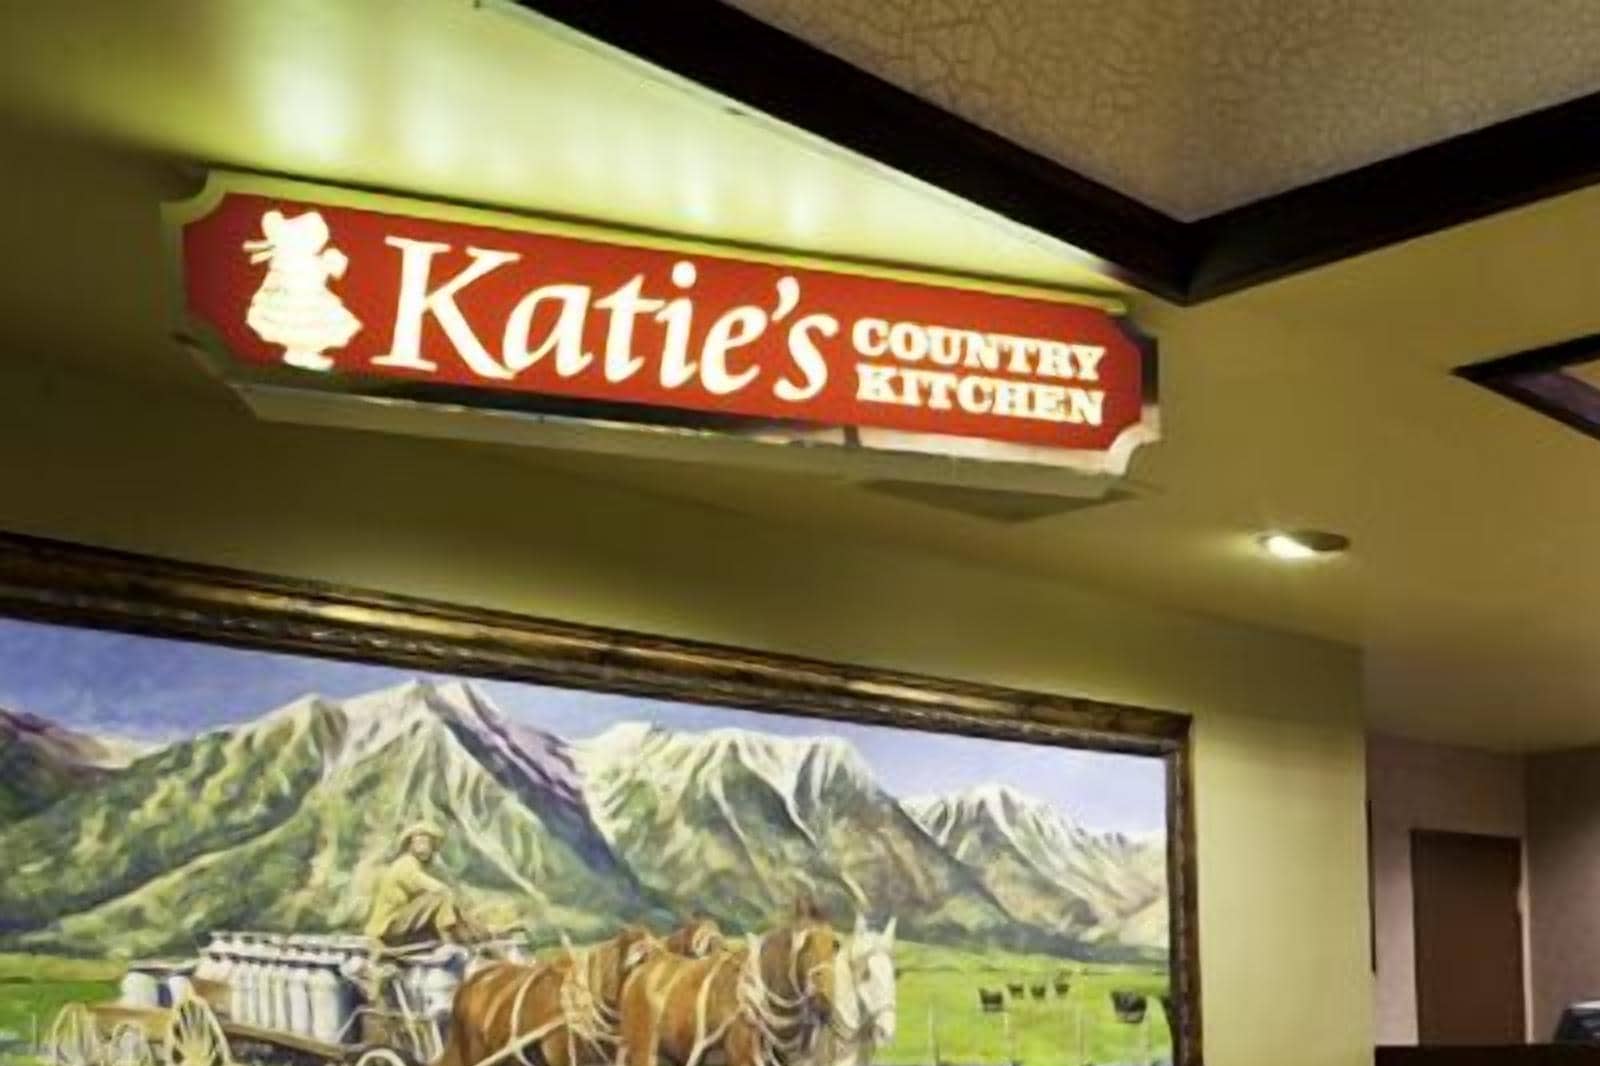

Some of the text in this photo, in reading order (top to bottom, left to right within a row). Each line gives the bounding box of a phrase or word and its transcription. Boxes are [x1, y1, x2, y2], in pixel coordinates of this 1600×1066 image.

[372, 236, 840, 402] Katie's
[854, 319, 1107, 382] COUNTRY
[857, 365, 1104, 427] KITCHEN
